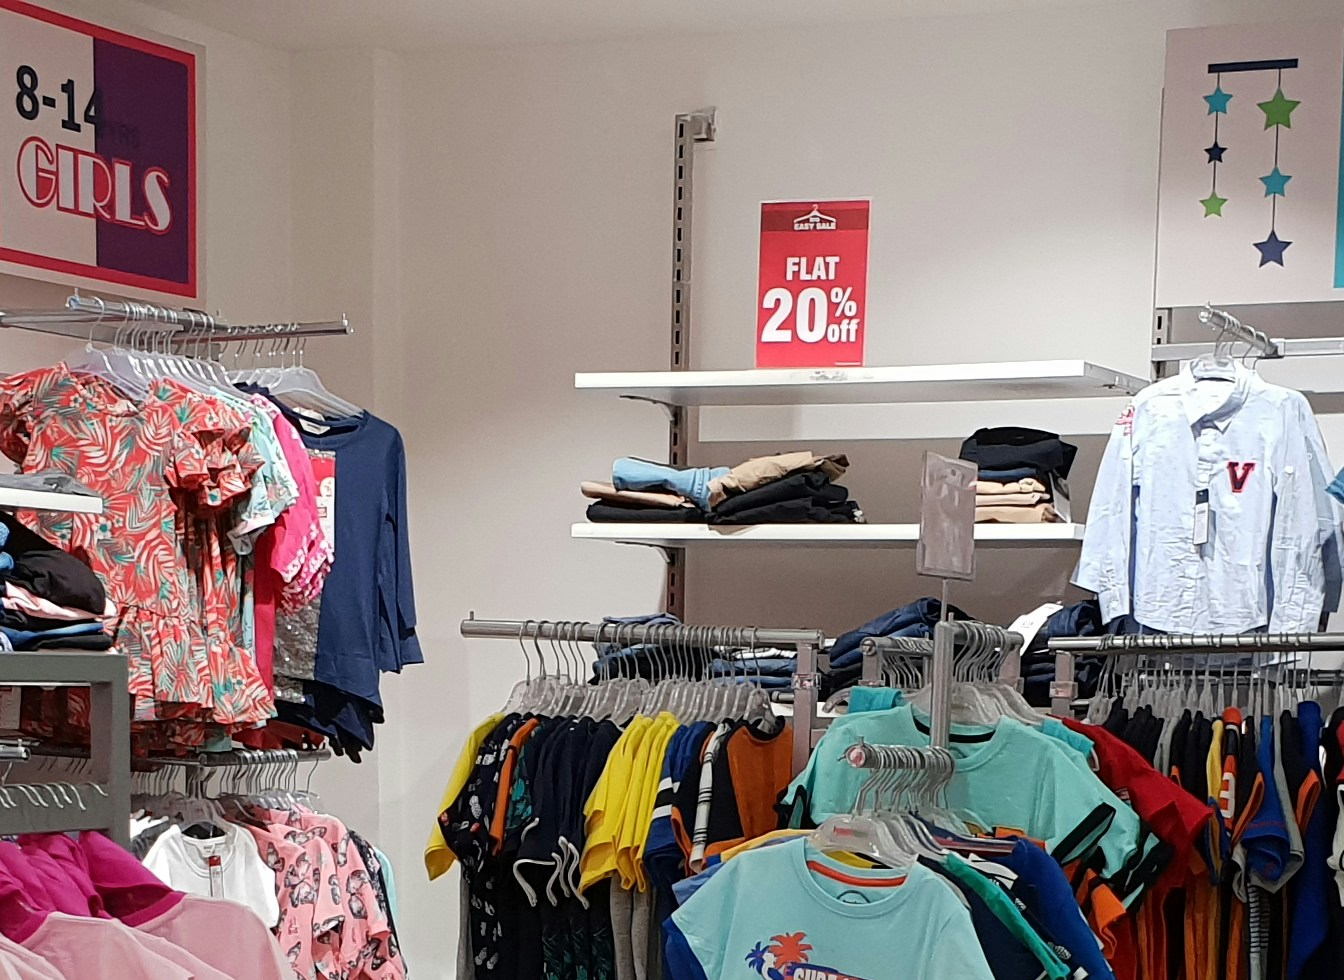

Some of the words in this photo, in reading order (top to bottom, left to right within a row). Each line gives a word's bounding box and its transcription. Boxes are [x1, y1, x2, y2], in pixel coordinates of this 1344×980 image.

[15, 64, 105, 137] 8-14
[17, 135, 173, 236] GIRLS
[786, 256, 840, 281] FLAT
[761, 286, 857, 343] 20%
[827, 319, 860, 343] off
[1227, 461, 1256, 493] V
